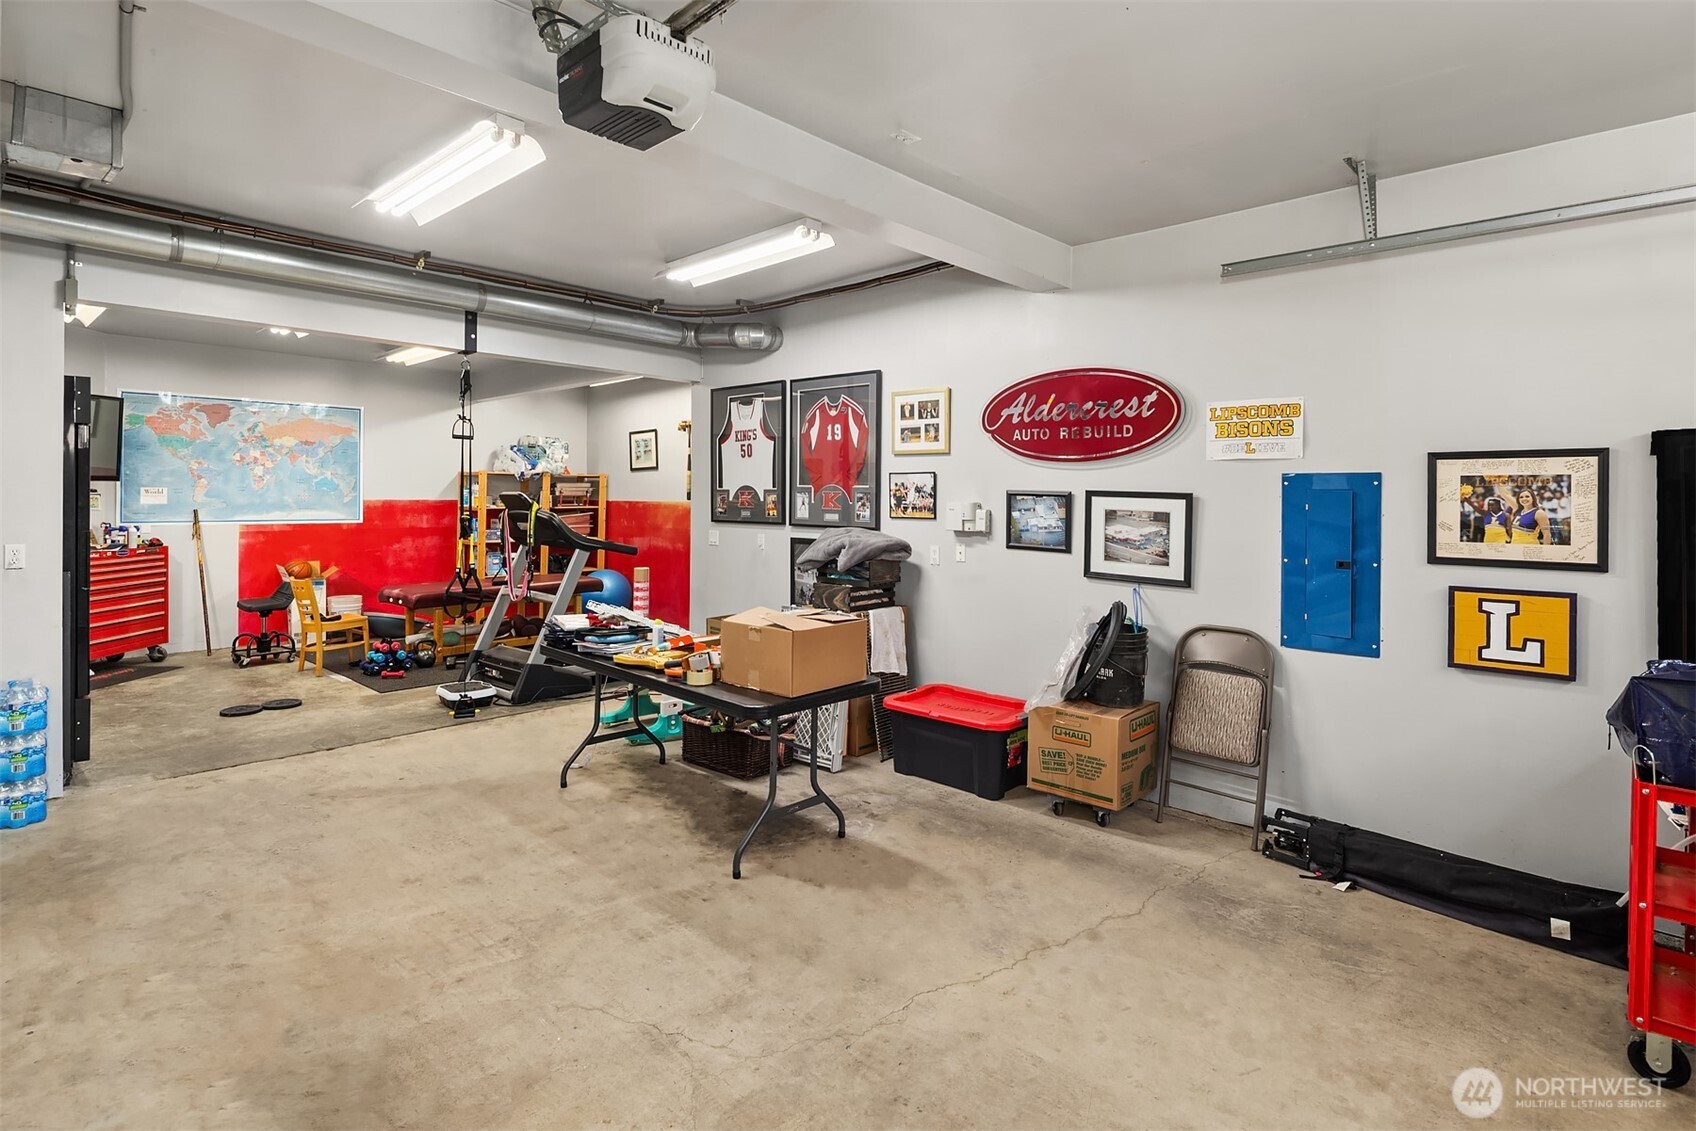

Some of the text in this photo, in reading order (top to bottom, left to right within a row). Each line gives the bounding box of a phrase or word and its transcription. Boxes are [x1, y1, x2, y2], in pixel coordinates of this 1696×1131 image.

[1001, 391, 1159, 424] Aldercrest
[1210, 403, 1301, 421] LIPSCOMB
[735, 429, 757, 442] KING'S
[827, 424, 842, 440] 19
[1013, 425, 1133, 441] AUTO REBUILD
[1215, 419, 1294, 438] BISONS
[740, 443, 753, 458] 50
[738, 490, 754, 508] K
[822, 491, 841, 510] K
[1478, 598, 1545, 668] L
[1055, 728, 1089, 742] U-HAUL
[1041, 750, 1066, 759] SAVE!
